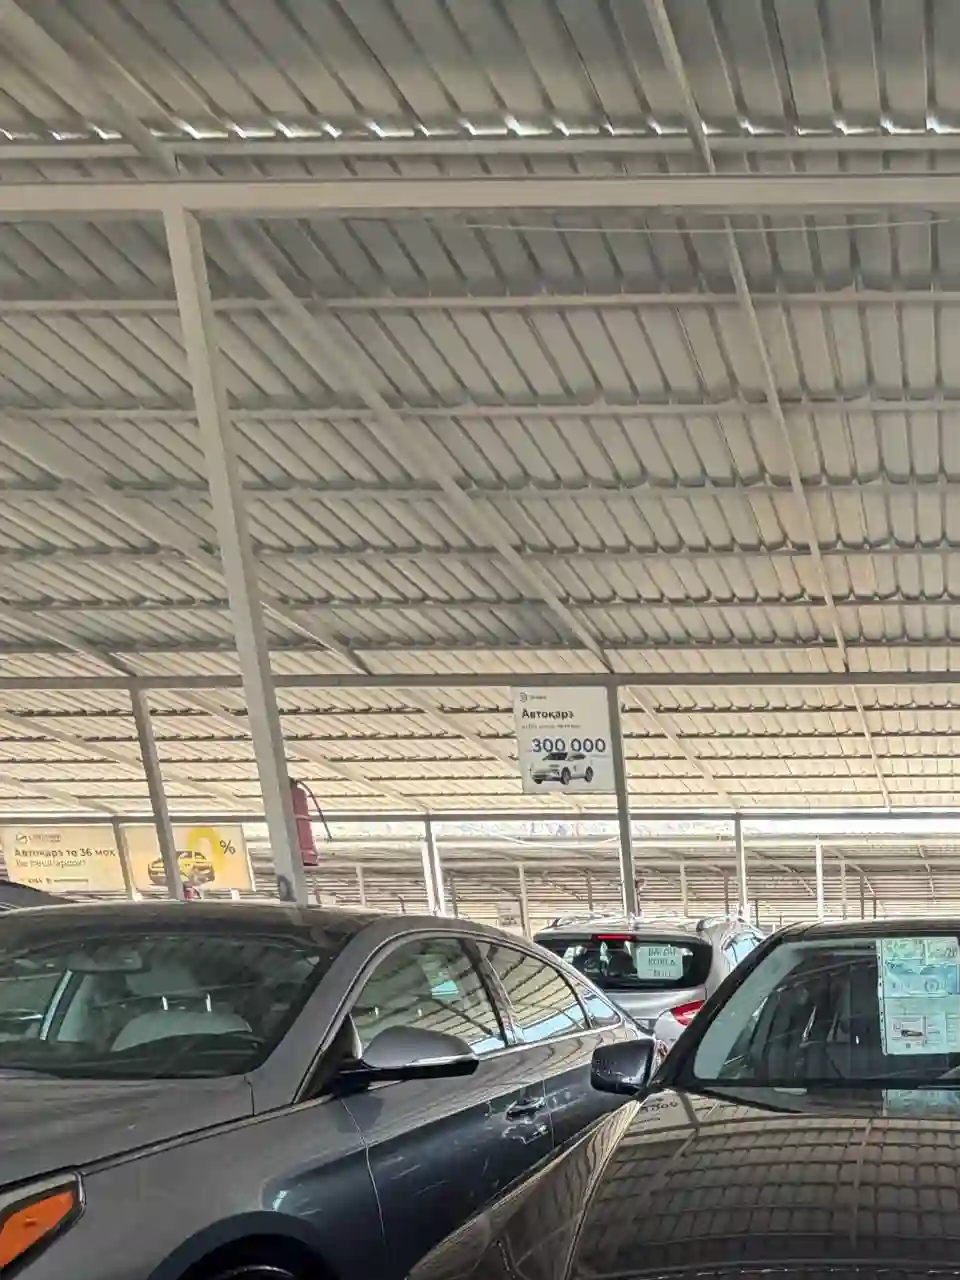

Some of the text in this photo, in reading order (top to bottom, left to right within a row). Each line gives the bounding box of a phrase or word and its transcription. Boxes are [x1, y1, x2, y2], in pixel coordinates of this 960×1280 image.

[532, 738, 606, 753] 300 000
[79, 848, 92, 857] 36
